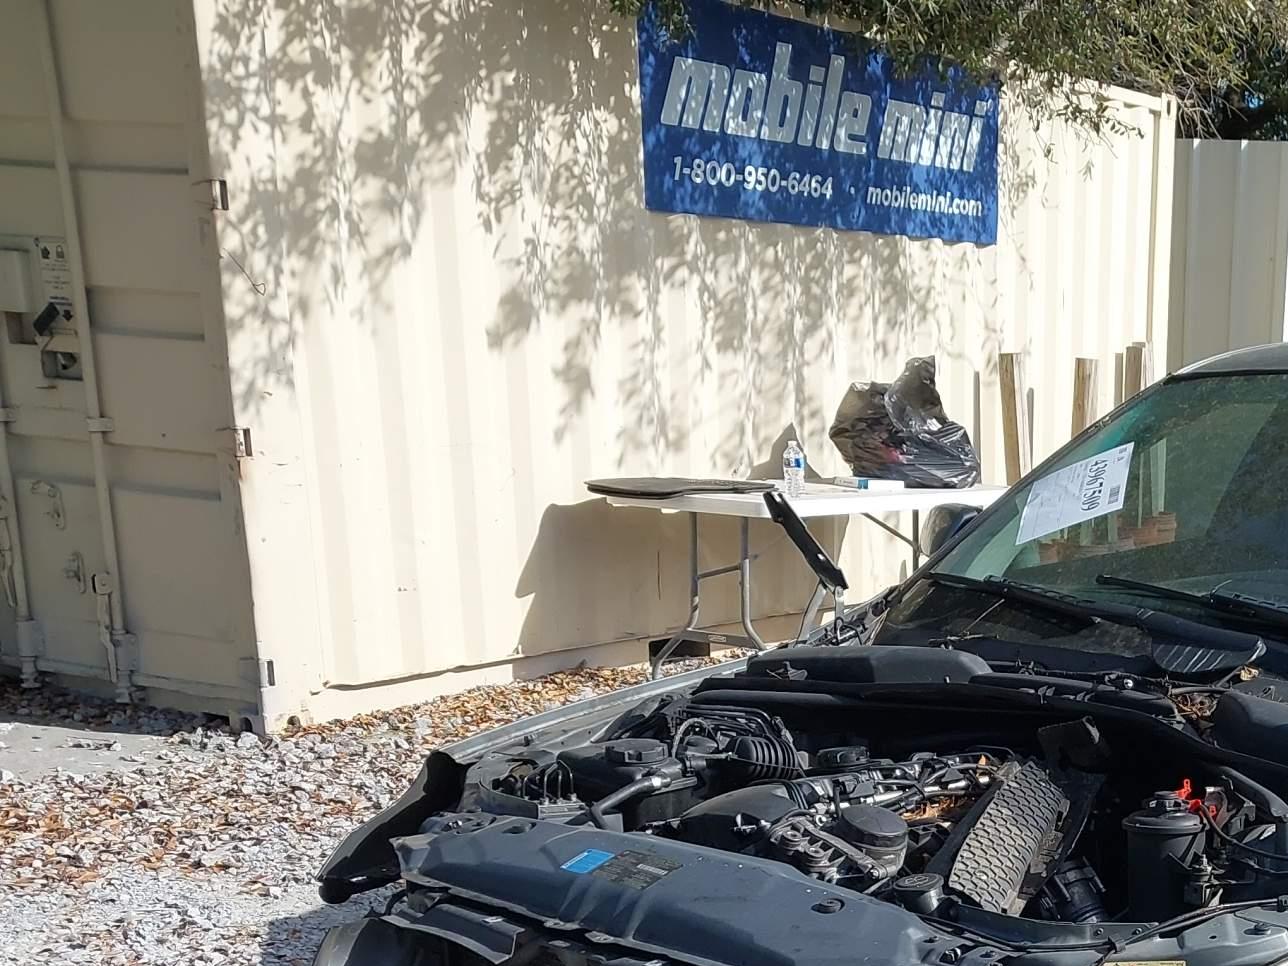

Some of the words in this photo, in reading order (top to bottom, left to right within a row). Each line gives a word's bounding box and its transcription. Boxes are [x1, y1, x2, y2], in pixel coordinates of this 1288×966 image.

[660, 41, 872, 155] mobile
[877, 91, 989, 173] mini
[673, 156, 833, 199] 1-800-950-6464
[866, 185, 983, 217] mobilemini.com
[1080, 459, 1109, 511] 43967509
